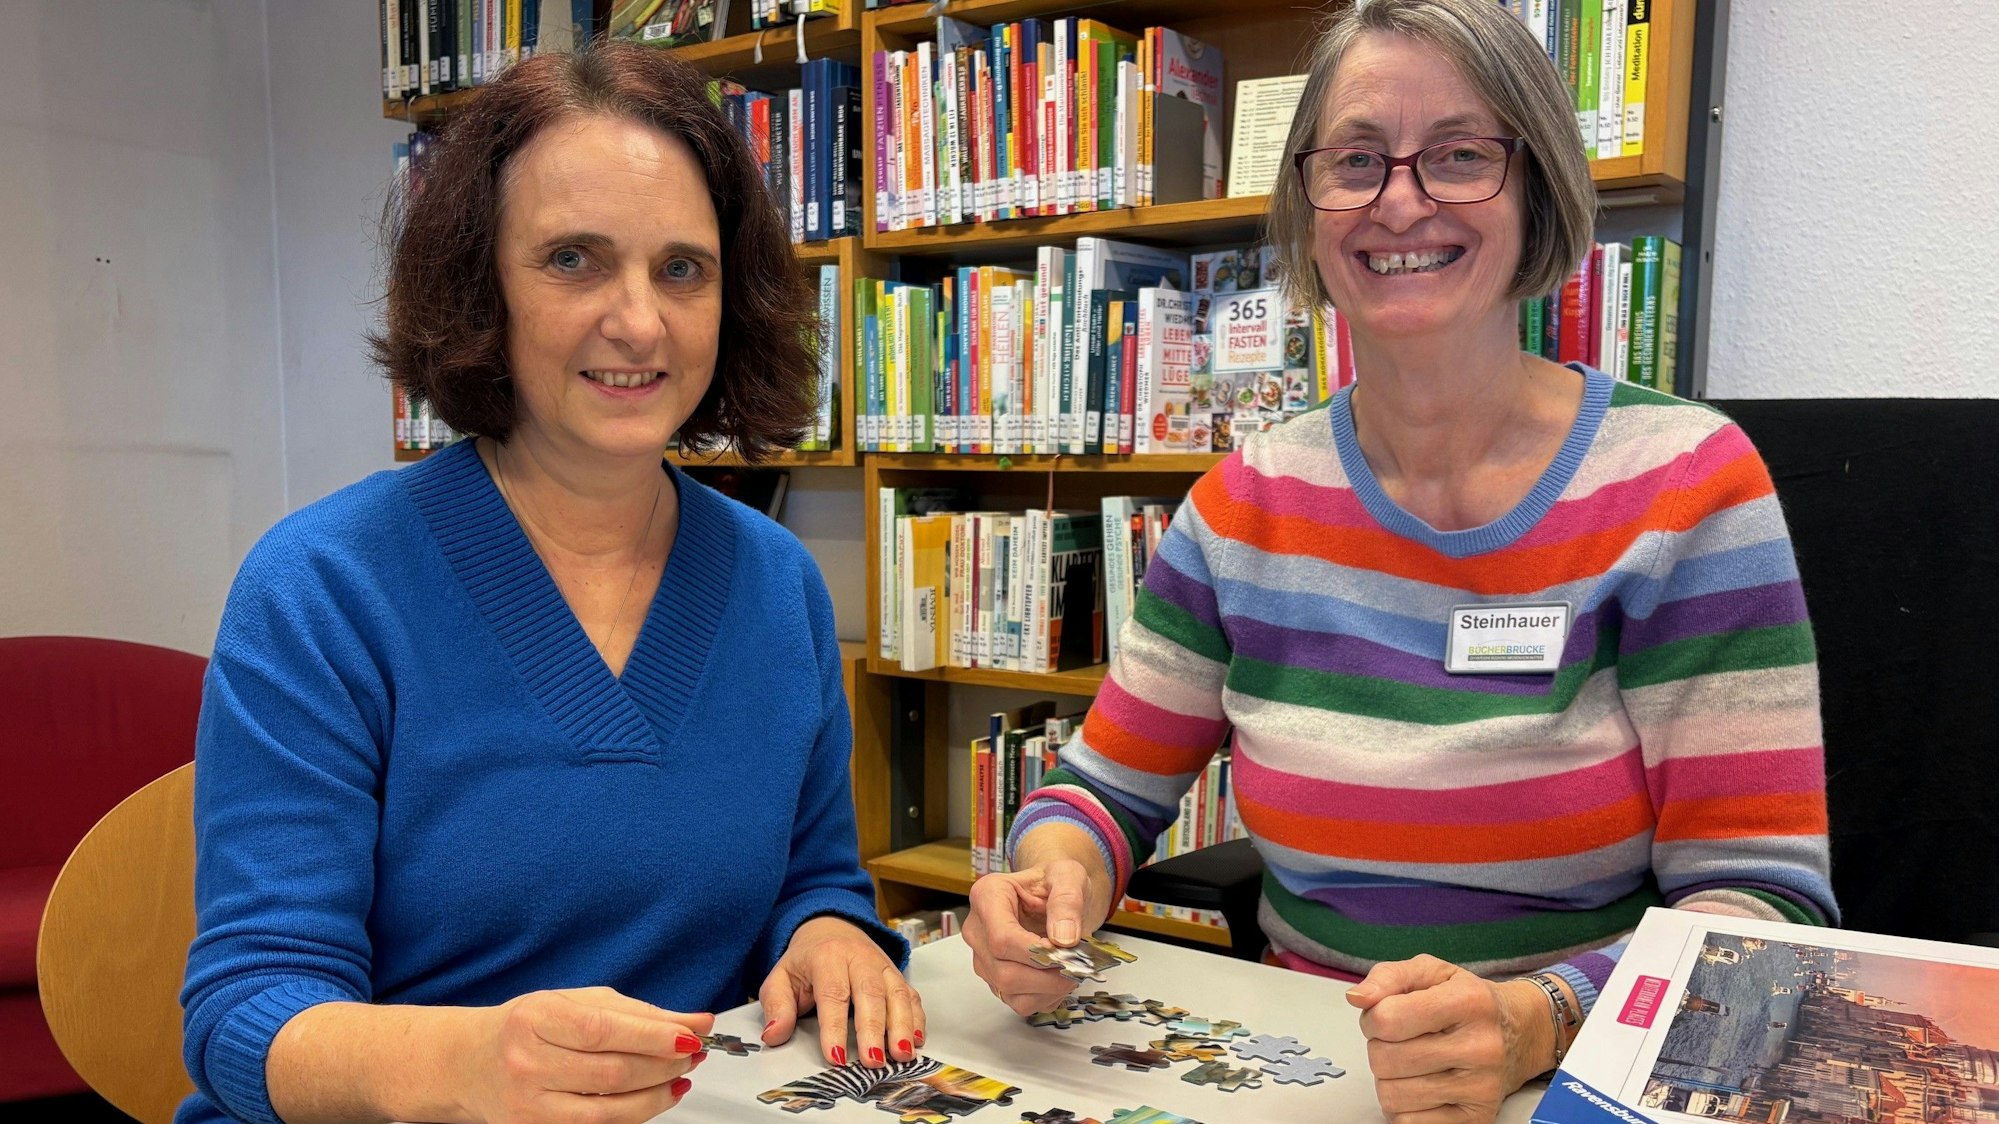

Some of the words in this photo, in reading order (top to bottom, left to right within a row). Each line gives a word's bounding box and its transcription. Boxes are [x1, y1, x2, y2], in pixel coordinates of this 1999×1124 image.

[1631, 29, 1642, 81] Meditation
[1168, 58, 1219, 89] Alexander
[1040, 263, 1049, 299] gesund!
[963, 316, 969, 324] IN
[1229, 299, 1267, 321] 365
[1644, 295, 1656, 328] ALTERNS
[997, 311, 1010, 364] HEILEN
[1063, 324, 1073, 363] Healing
[1228, 335, 1267, 350] FASTEN
[1229, 320, 1268, 335] Intervall
[1633, 310, 1644, 350] GEHEIMNIS
[1228, 351, 1267, 365] Rezepte
[1633, 351, 1641, 365] DAS
[1642, 329, 1655, 366] GESUNDEN
[1106, 514, 1114, 552] GEHIRN
[1114, 517, 1122, 552] PSYCHE
[1108, 552, 1116, 594] GESUNDES
[1024, 584, 1032, 623] LIGHTSPEED
[1461, 613, 1560, 630] Steinhauer
[1008, 759, 1018, 791] gestresste
[1184, 795, 1192, 808] HAT
[1182, 808, 1191, 848] DEUTSCHLAND
